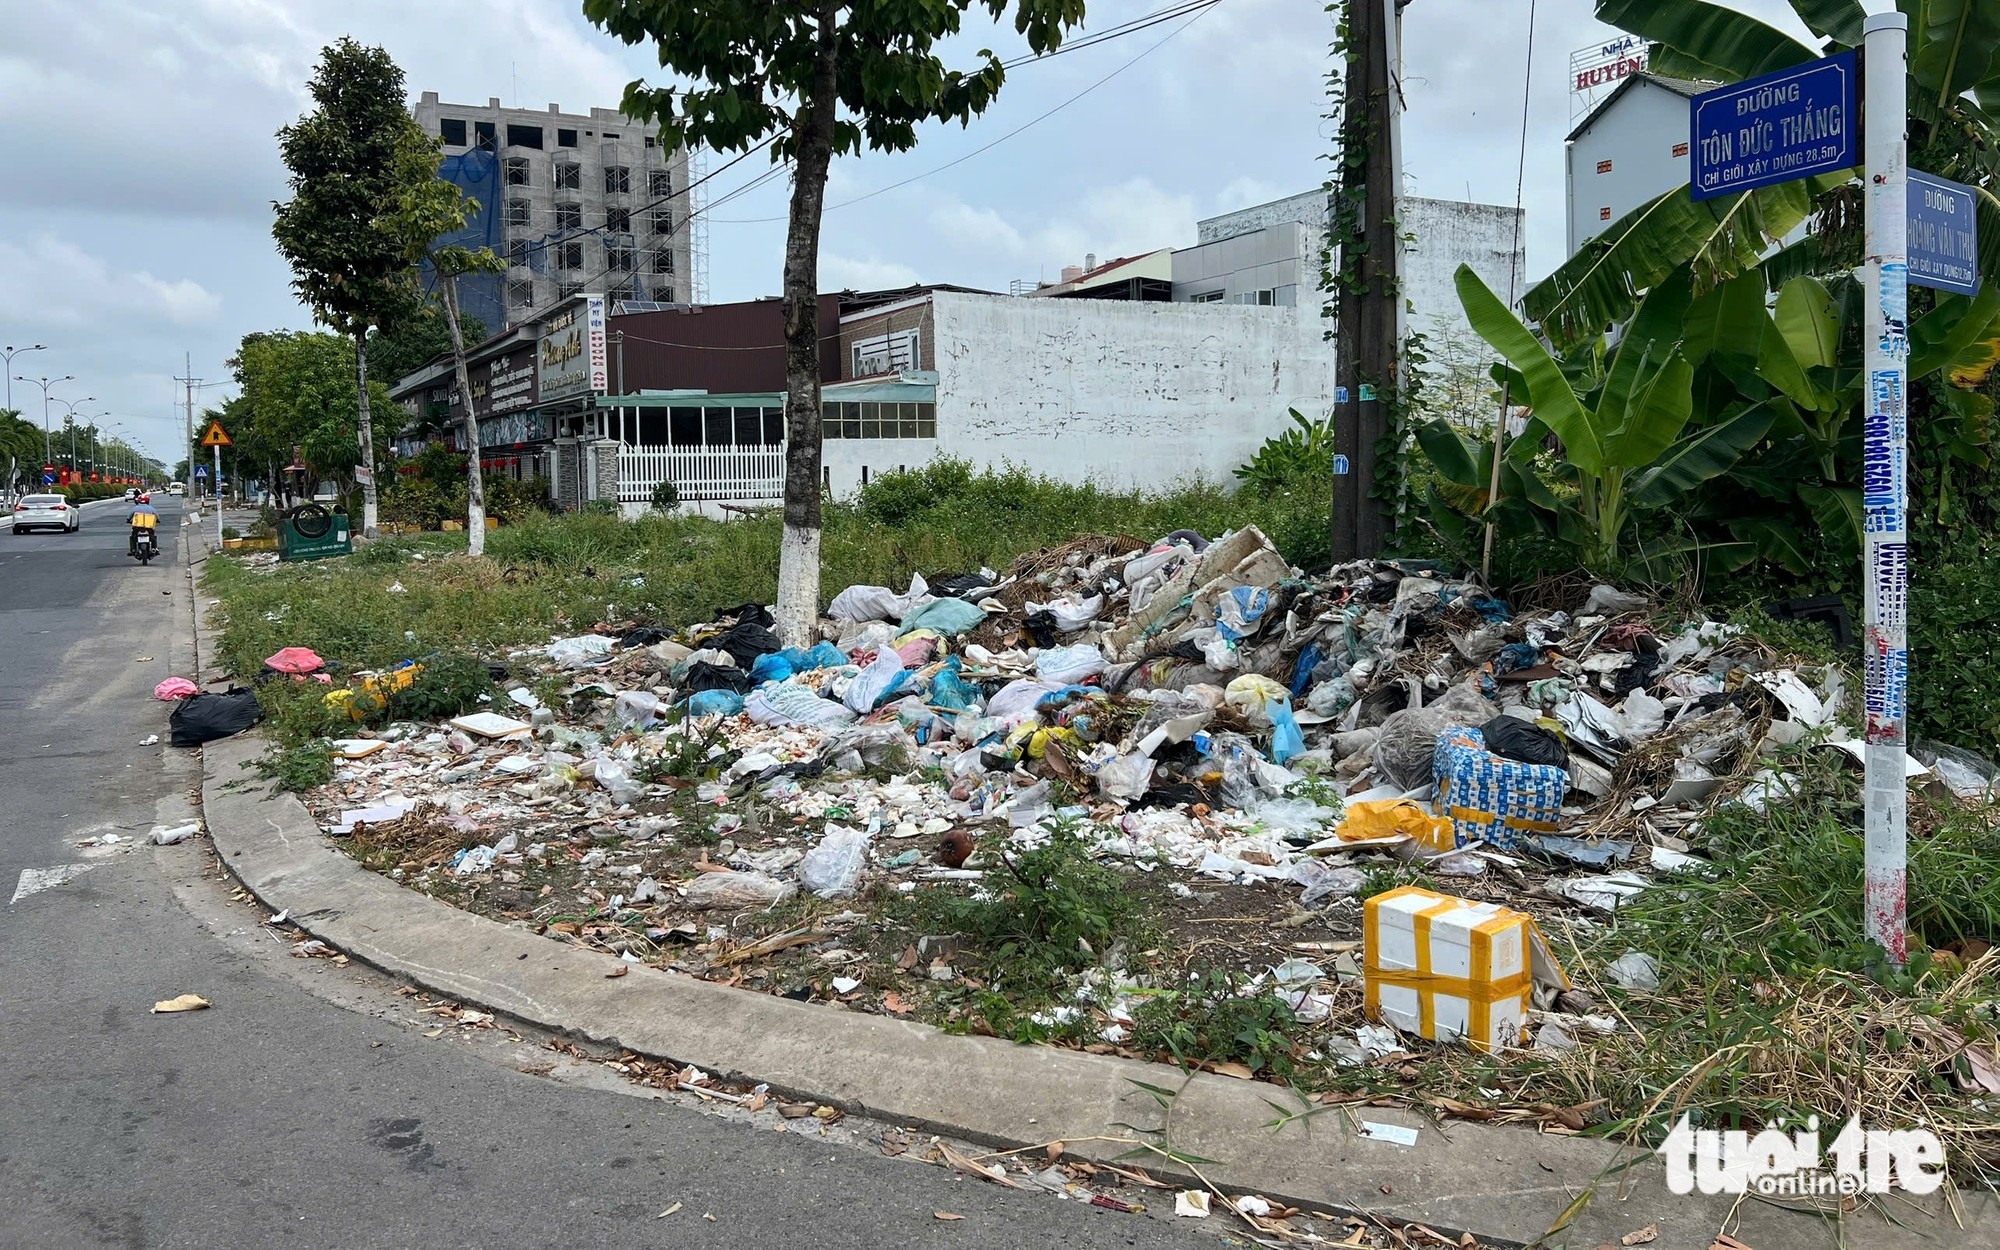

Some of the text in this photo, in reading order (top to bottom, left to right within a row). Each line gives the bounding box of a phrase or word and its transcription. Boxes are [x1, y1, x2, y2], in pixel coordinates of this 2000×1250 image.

[1602, 36, 1634, 56] NHÀ
[1736, 82, 1800, 117] ĐƯỜNG
[1701, 98, 1841, 167] TÔN ĐỨC THẮNG
[1704, 144, 1837, 187] CHỈ GIỚI XÂY DỰNG 28,5m
[1925, 189, 1955, 214] ĐƯỜNG
[1907, 212, 1974, 267] HOÀNG VĂN THỤ
[593, 371, 605, 388] ANH
